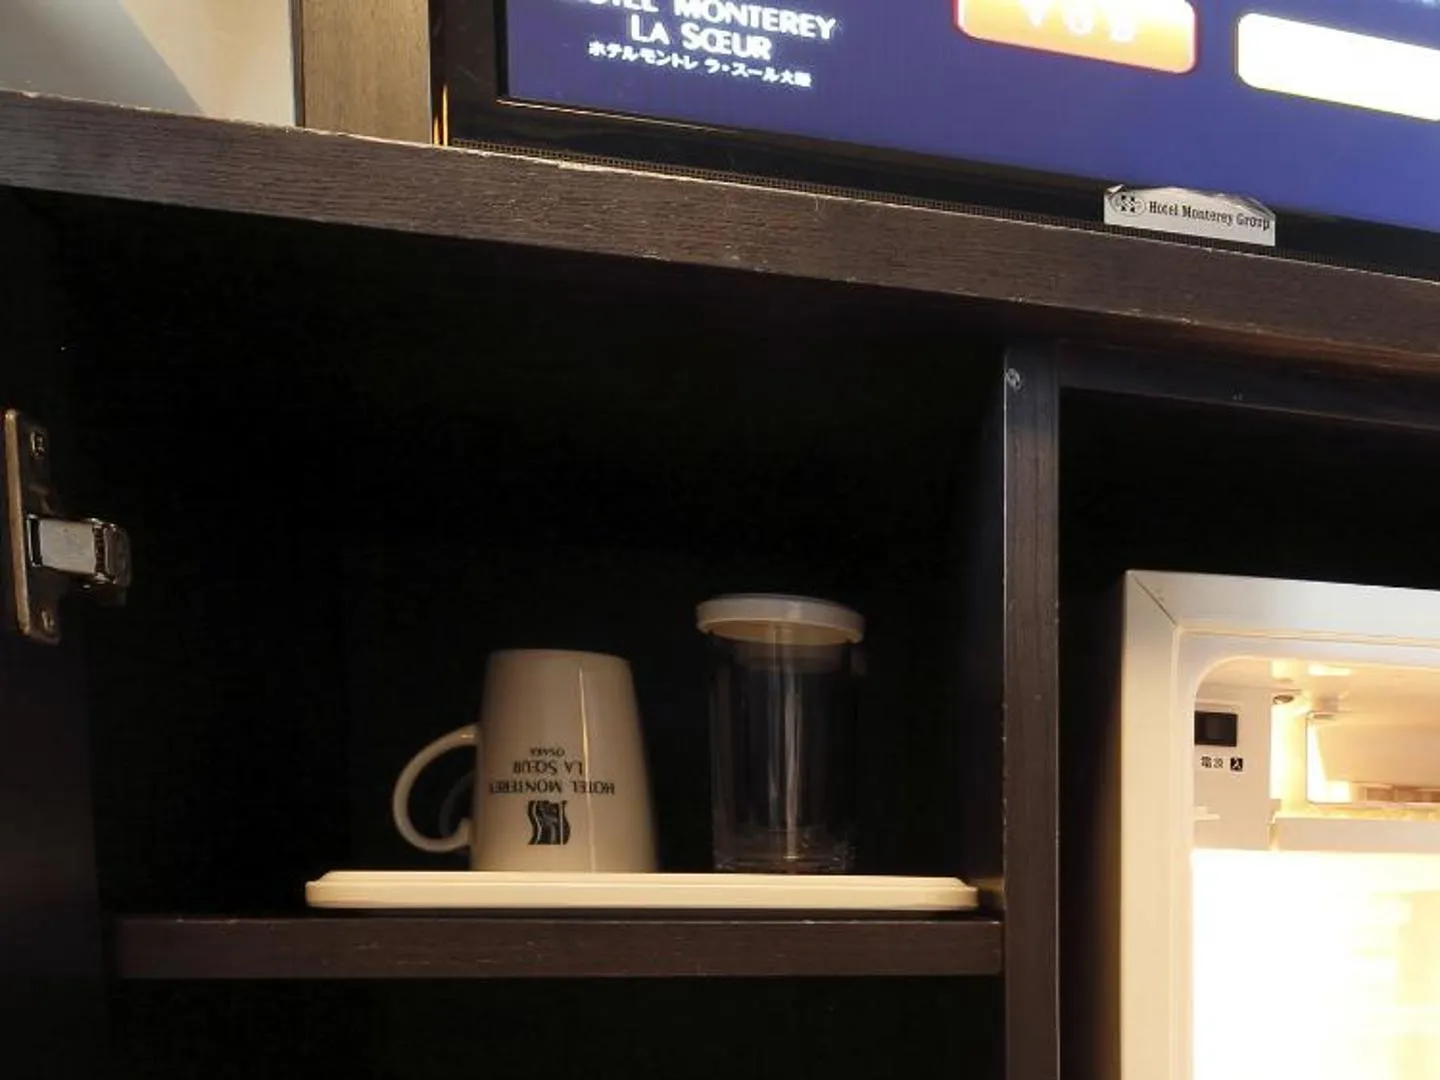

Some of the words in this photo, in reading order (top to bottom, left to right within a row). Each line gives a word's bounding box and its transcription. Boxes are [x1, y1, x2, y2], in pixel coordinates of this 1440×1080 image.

[629, 14, 670, 45] LA
[588, 41, 699, 71] ホテルモントレ
[1149, 201, 1179, 217] Hotel
[1181, 205, 1234, 227] Monterey
[572, 780, 616, 796] HOTEL
